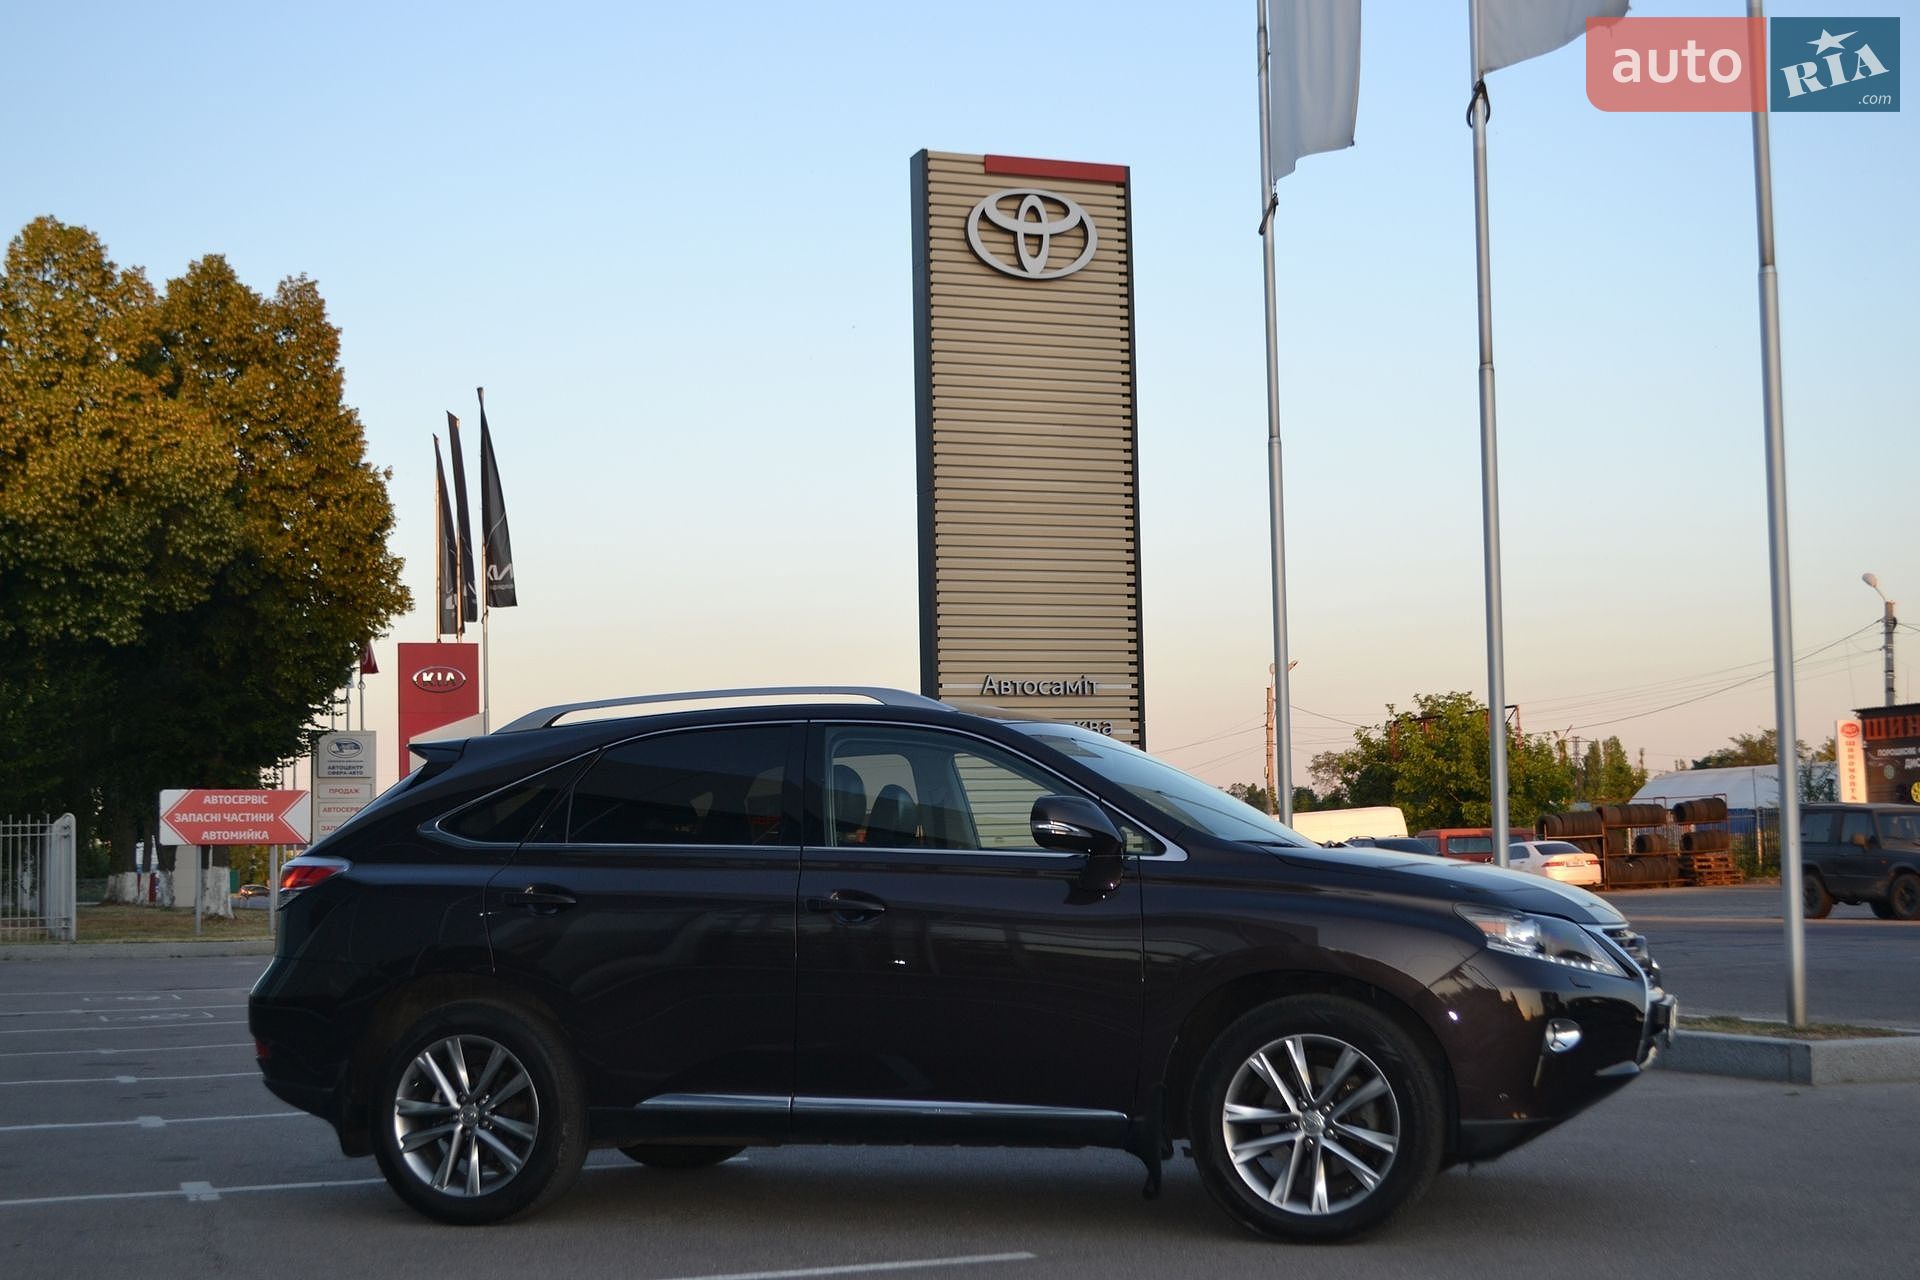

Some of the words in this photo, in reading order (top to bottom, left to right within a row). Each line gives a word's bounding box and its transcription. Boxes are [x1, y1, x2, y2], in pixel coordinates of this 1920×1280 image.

[422, 671, 456, 687] KIA
[982, 673, 1097, 696] Автосаміт
[328, 787, 360, 795] ПРОДАЖ
[203, 795, 269, 805] АВТОСЕРВІС
[174, 813, 221, 823] ЗАПАСНІ
[223, 813, 274, 823] ЧАСТИНИ
[201, 829, 270, 840] АВТОМИЙКА
